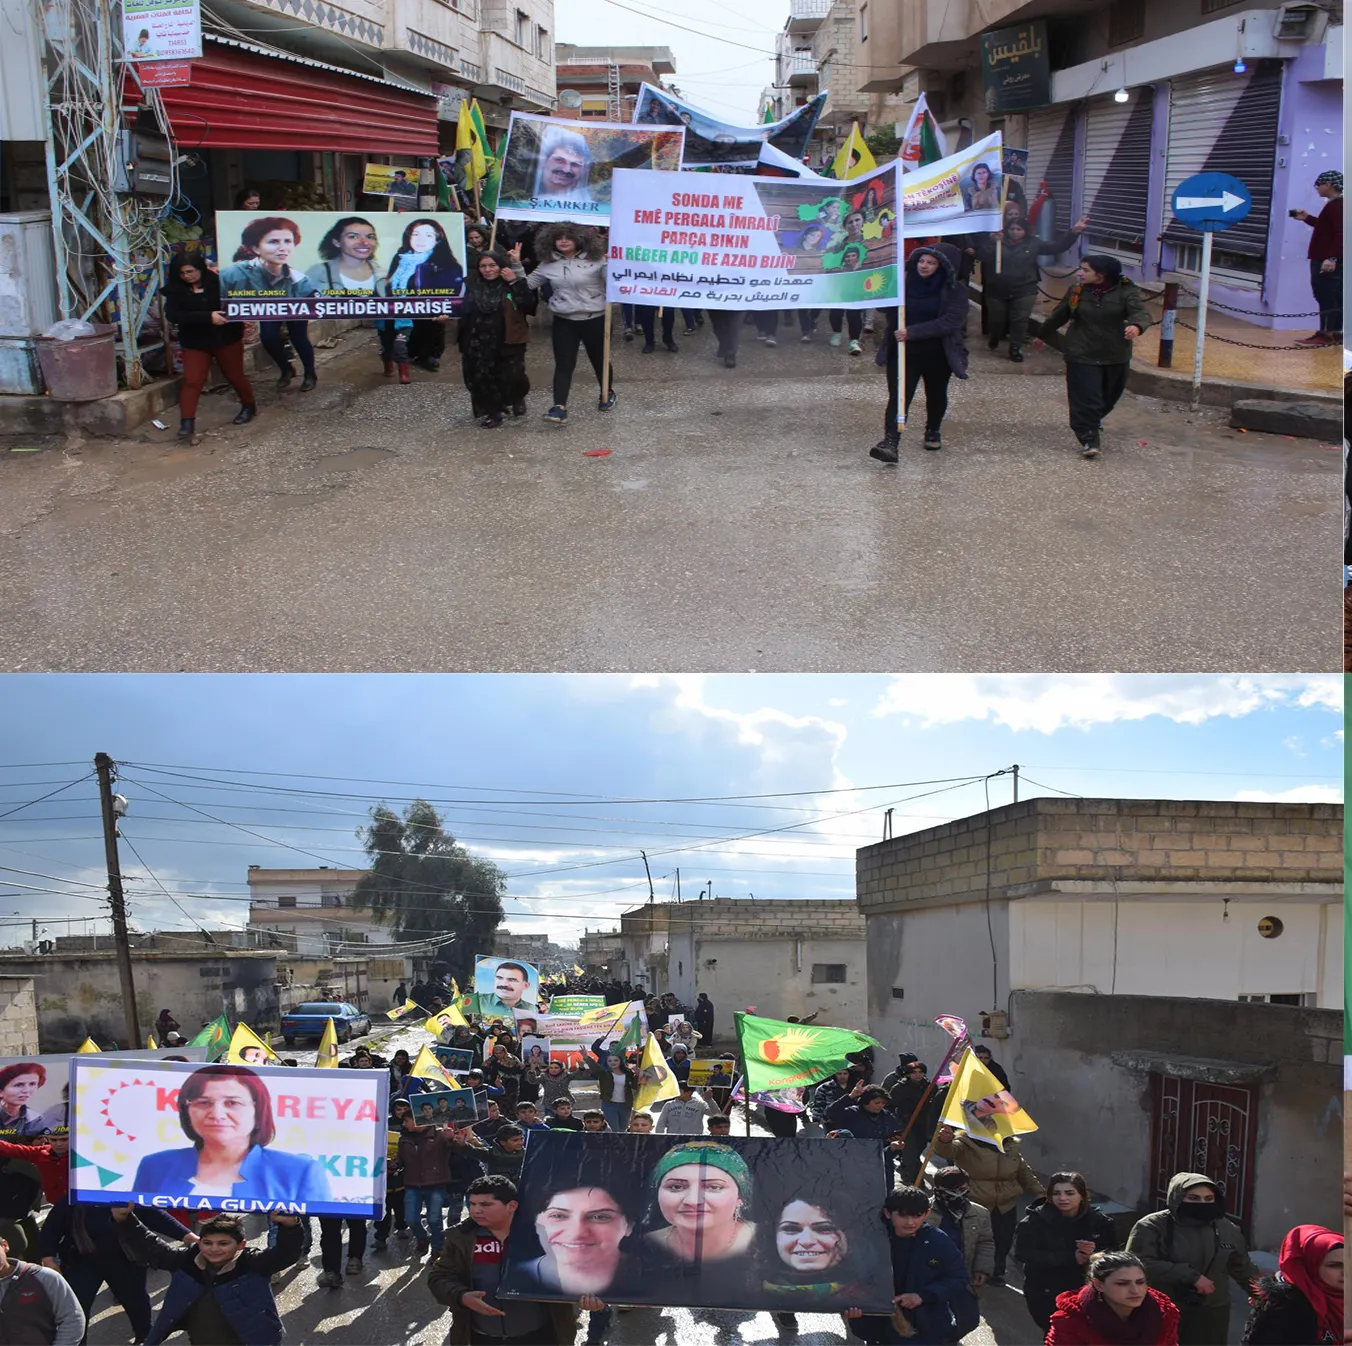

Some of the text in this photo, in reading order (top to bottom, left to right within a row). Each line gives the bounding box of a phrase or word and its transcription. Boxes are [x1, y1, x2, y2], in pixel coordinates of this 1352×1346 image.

[672, 192, 744, 210] SONDA ME
[633, 208, 781, 232] EMÊ PERGALA ÎMRALÎ
[660, 230, 750, 249] PARÇA BIKIN
[610, 245, 796, 269] BI RÊBER APO RE AZAD BIJÎN
[749, 279, 771, 287] هو
[228, 302, 310, 317] DEWREYA
[315, 299, 389, 319] ŞEHÎDÊN
[138, 1194, 307, 1215] LEYLA GUVAN
